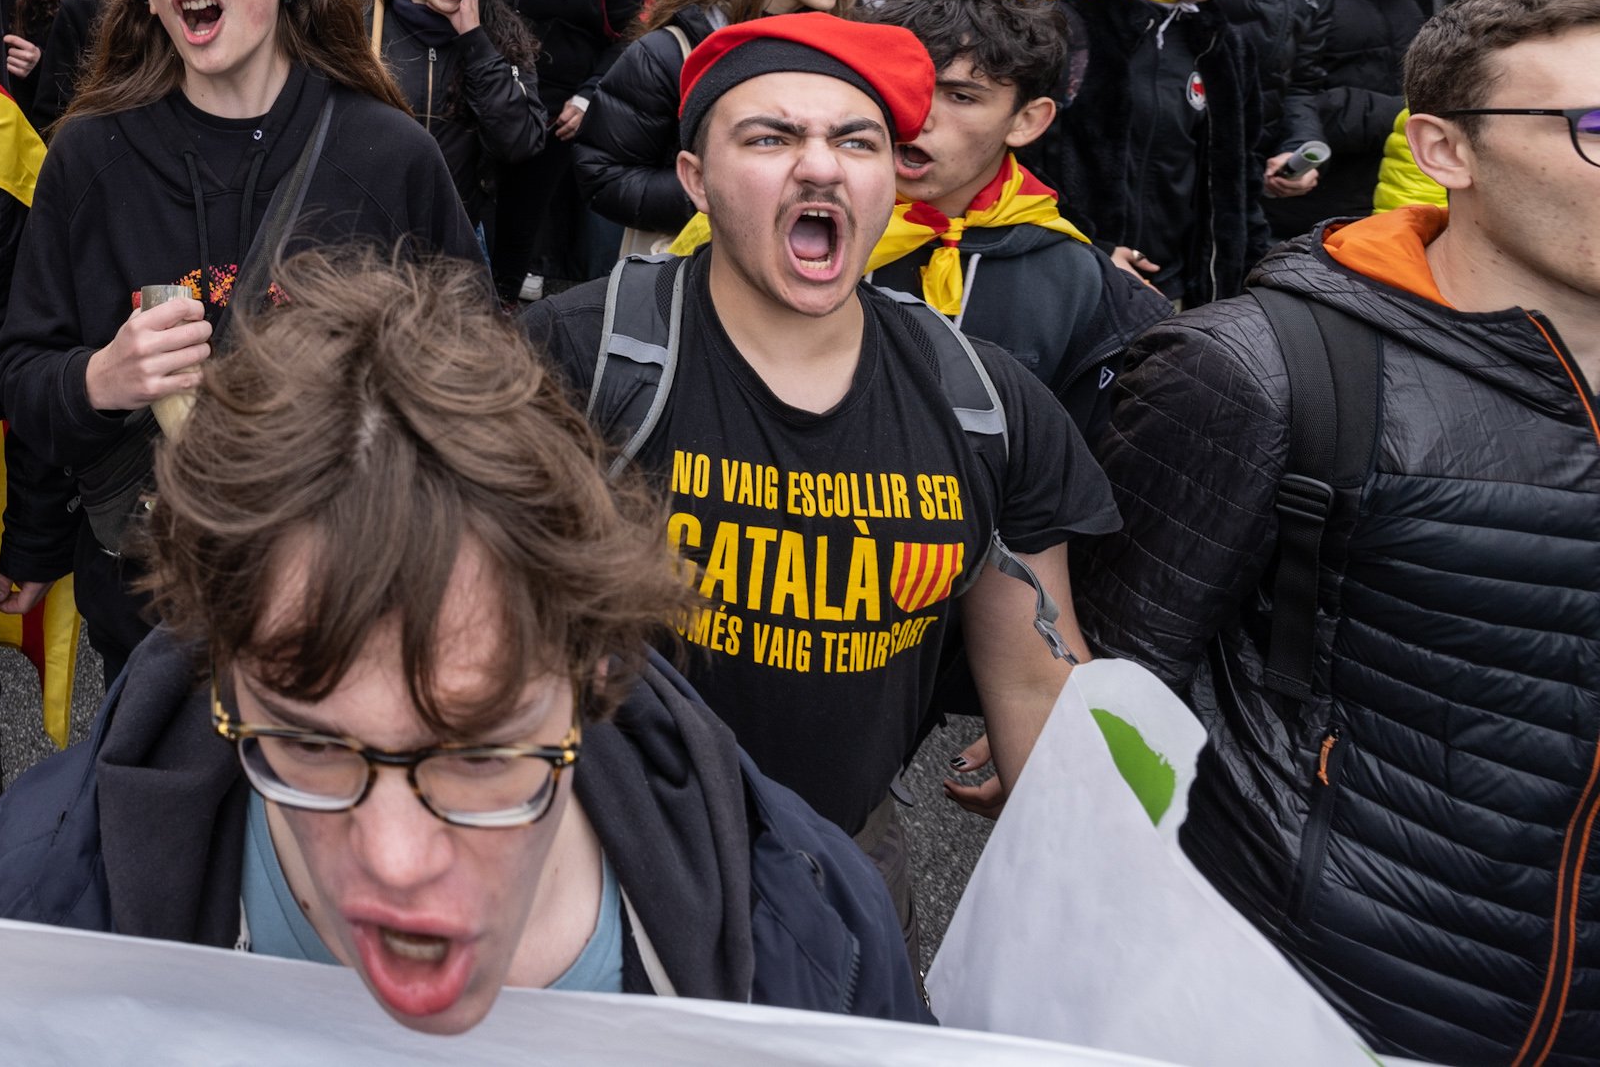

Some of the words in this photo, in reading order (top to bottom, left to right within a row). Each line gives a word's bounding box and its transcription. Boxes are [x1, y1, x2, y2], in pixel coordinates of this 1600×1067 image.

[671, 449, 711, 499] NO
[721, 458, 779, 510] VAIG
[787, 470, 912, 519] ESCOLLIR
[916, 473, 964, 521] SER
[666, 511, 881, 622] CATALÀ
[666, 604, 744, 657] OMÉS
[753, 622, 812, 673] VAIG
[821, 630, 890, 673] TENIR
[889, 615, 939, 661] SORT
